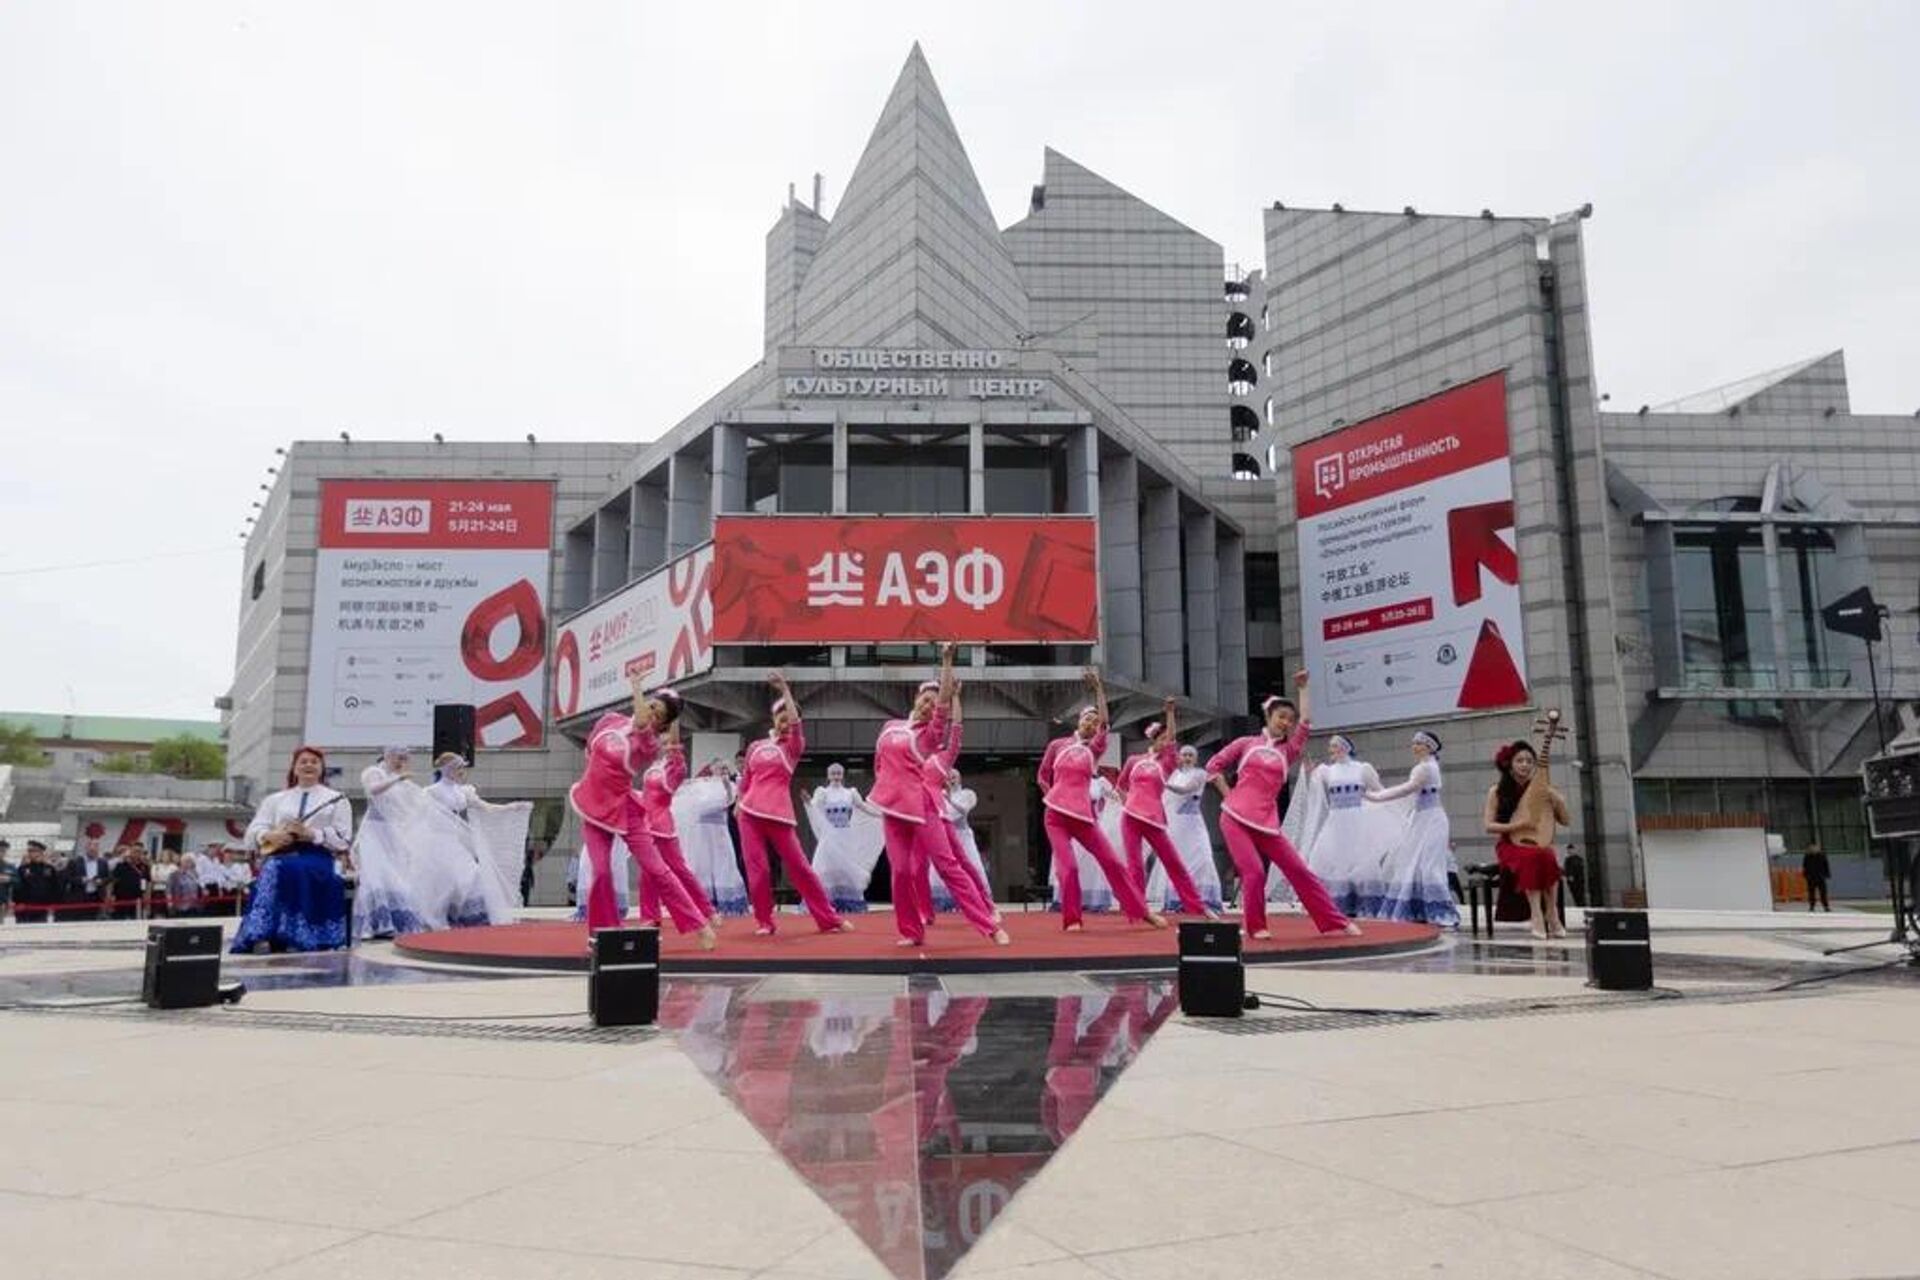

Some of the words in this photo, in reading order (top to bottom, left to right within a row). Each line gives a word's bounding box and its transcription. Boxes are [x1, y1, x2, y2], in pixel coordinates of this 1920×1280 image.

[784, 373, 949, 396] КУЛЬТУРНЫЙ
[967, 377, 1045, 399] ЦЕНТР
[1347, 434, 1403, 464] ОТКРЫТАЯ
[1348, 436, 1460, 481] ПРОМЫШЛЕННОСТЬ
[377, 505, 423, 527] АЭФ
[449, 501, 485, 513] 21-24
[487, 503, 512, 513] мая
[448, 518, 518, 533] 5月21-24日
[876, 547, 1004, 611] АЭФ
